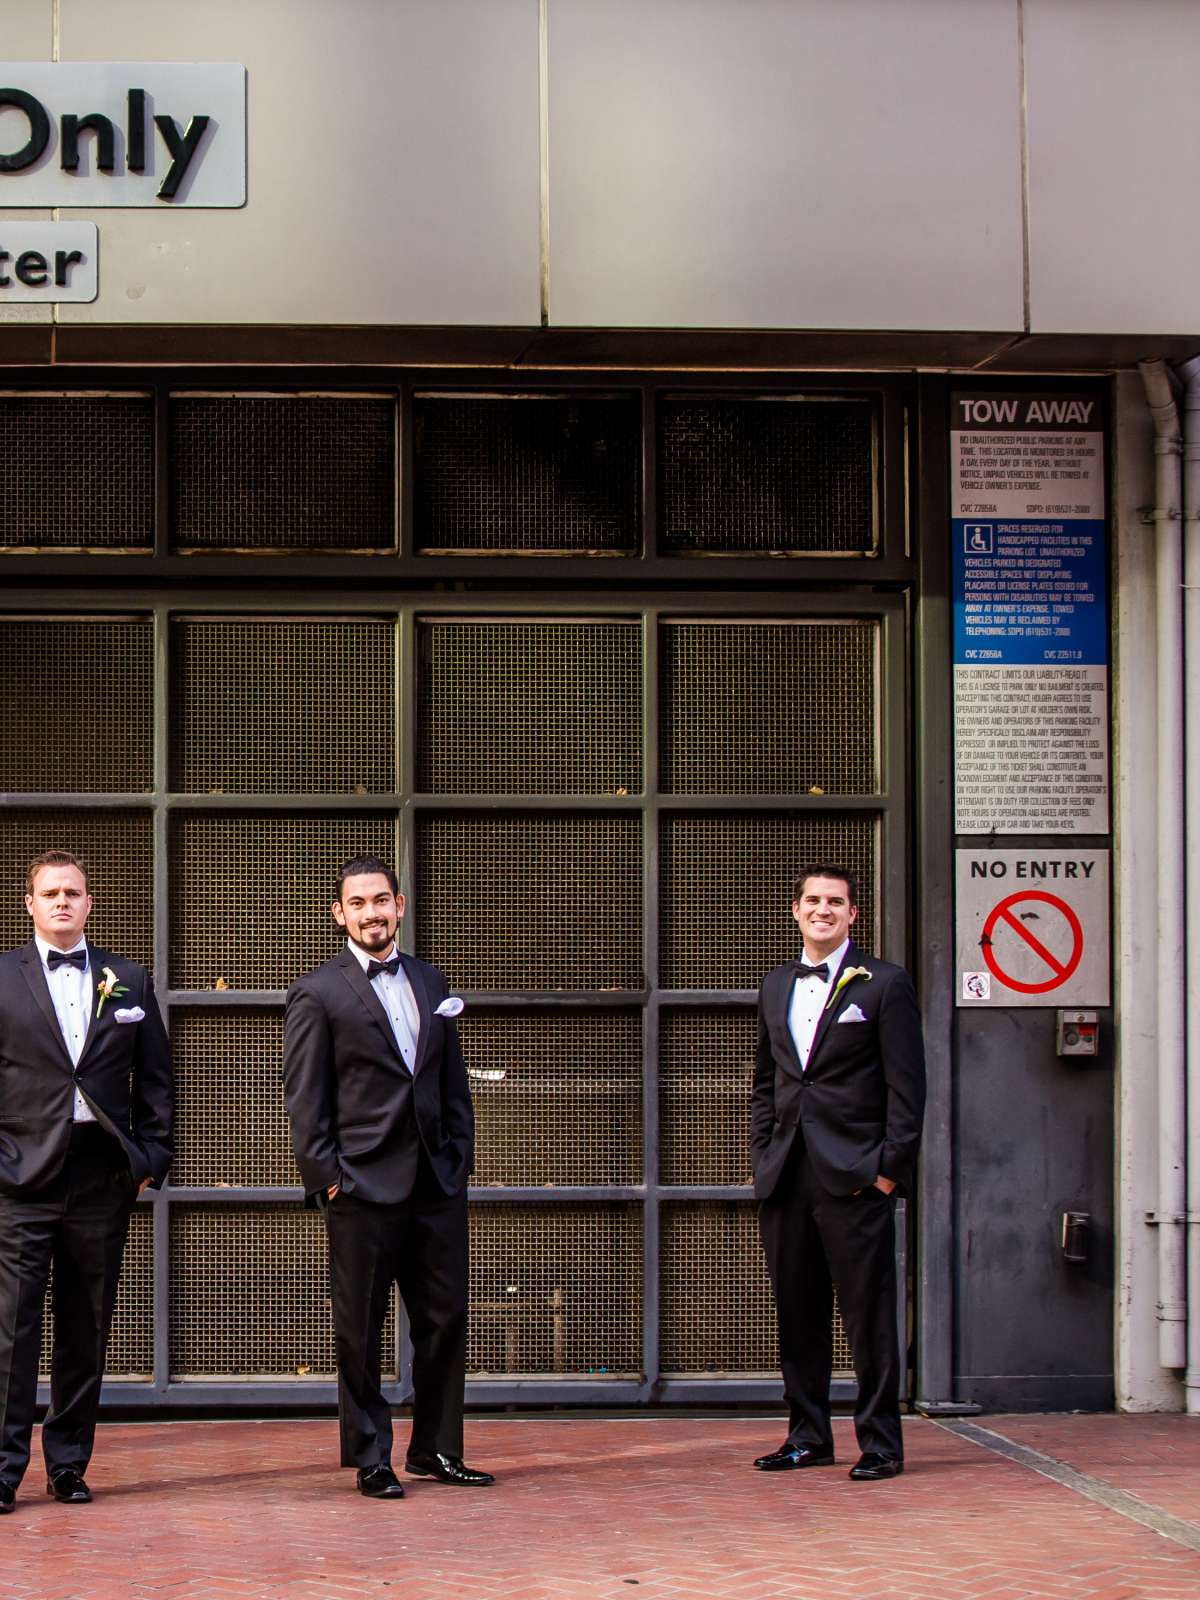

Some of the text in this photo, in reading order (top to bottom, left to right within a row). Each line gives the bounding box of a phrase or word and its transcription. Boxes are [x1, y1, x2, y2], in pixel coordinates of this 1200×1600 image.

[960, 400, 1094, 424] TOW AWAY
[993, 448, 1021, 456] LOCATION
[960, 504, 972, 512] CVC
[964, 559, 991, 568] VEHICLES
[965, 616, 992, 625] VEHICLES
[965, 650, 977, 659] CVC
[1044, 650, 1056, 659] CVC
[970, 670, 1000, 679] CONTRACT
[1002, 670, 1021, 679] LIMITS
[1023, 670, 1035, 679] OUR
[971, 861, 1095, 878] NO ENTRY
